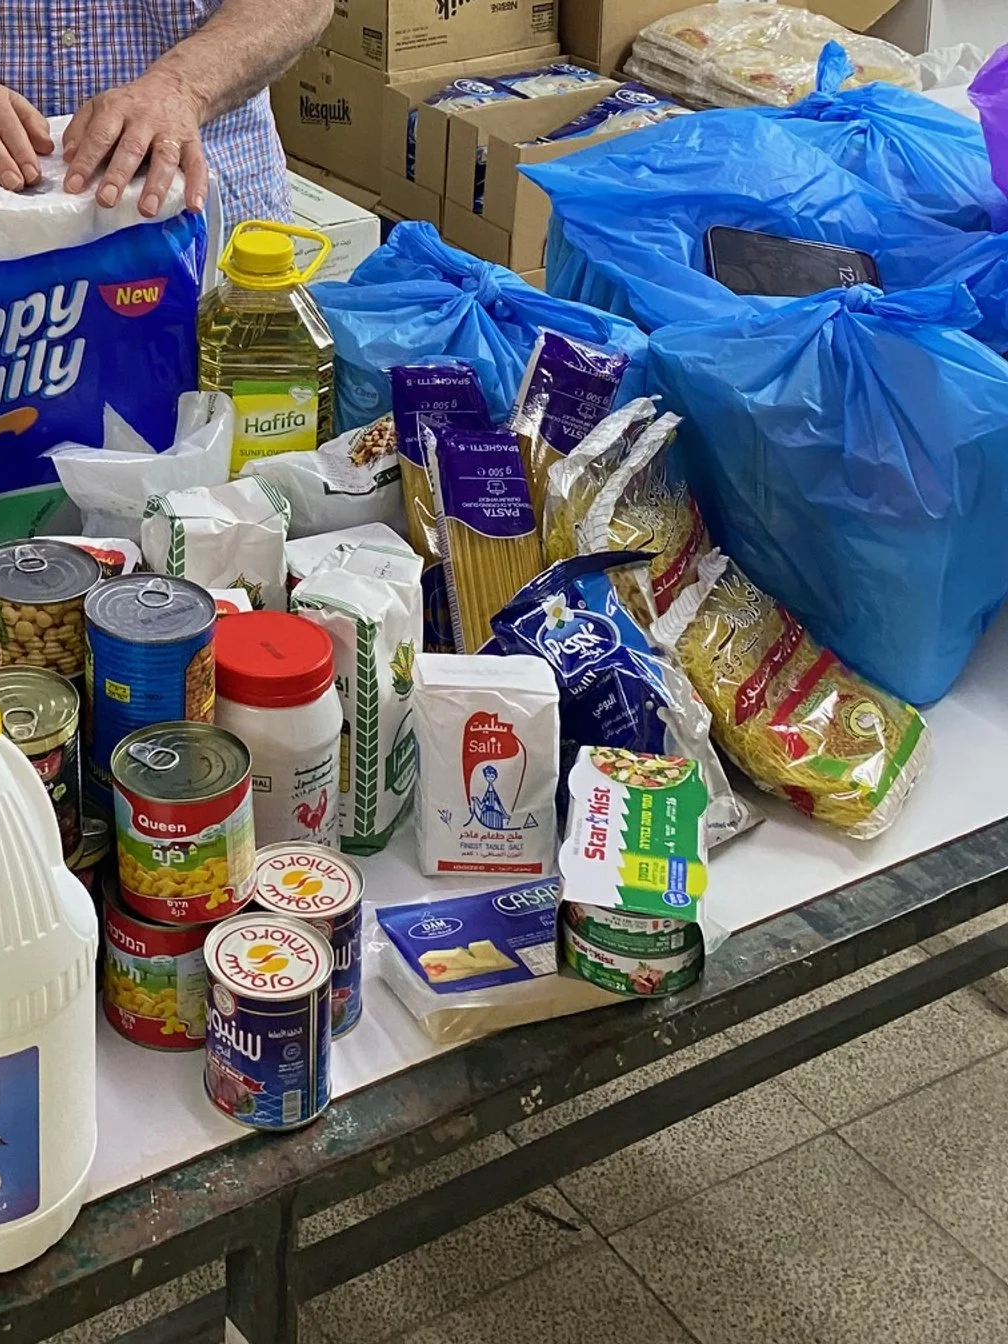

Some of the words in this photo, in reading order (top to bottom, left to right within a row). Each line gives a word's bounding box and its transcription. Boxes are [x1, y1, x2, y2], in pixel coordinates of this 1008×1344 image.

[299, 94, 352, 131] Nesquik
[116, 286, 160, 306] New
[433, 401, 449, 409] 500
[586, 392, 602, 403] 500
[244, 411, 306, 435] Hafifa
[563, 424, 587, 440] STA
[489, 468, 503, 477] 500
[483, 507, 520, 517] PASTA
[544, 622, 609, 665] Puck
[569, 669, 598, 695] DAILY
[470, 717, 508, 733] سليت
[469, 737, 502, 755] Salit
[137, 814, 187, 833] Queen
[459, 832, 479, 840] فاخر
[480, 831, 505, 842] طعام
[506, 834, 522, 842] ملح
[460, 842, 483, 850] FINEST
[486, 842, 505, 850] TABLE
[268, 855, 345, 884] siniora
[166, 899, 189, 908] תירס
[422, 920, 446, 931] DAM
[240, 927, 314, 965] siniora
[207, 1006, 261, 1062] سنيو
